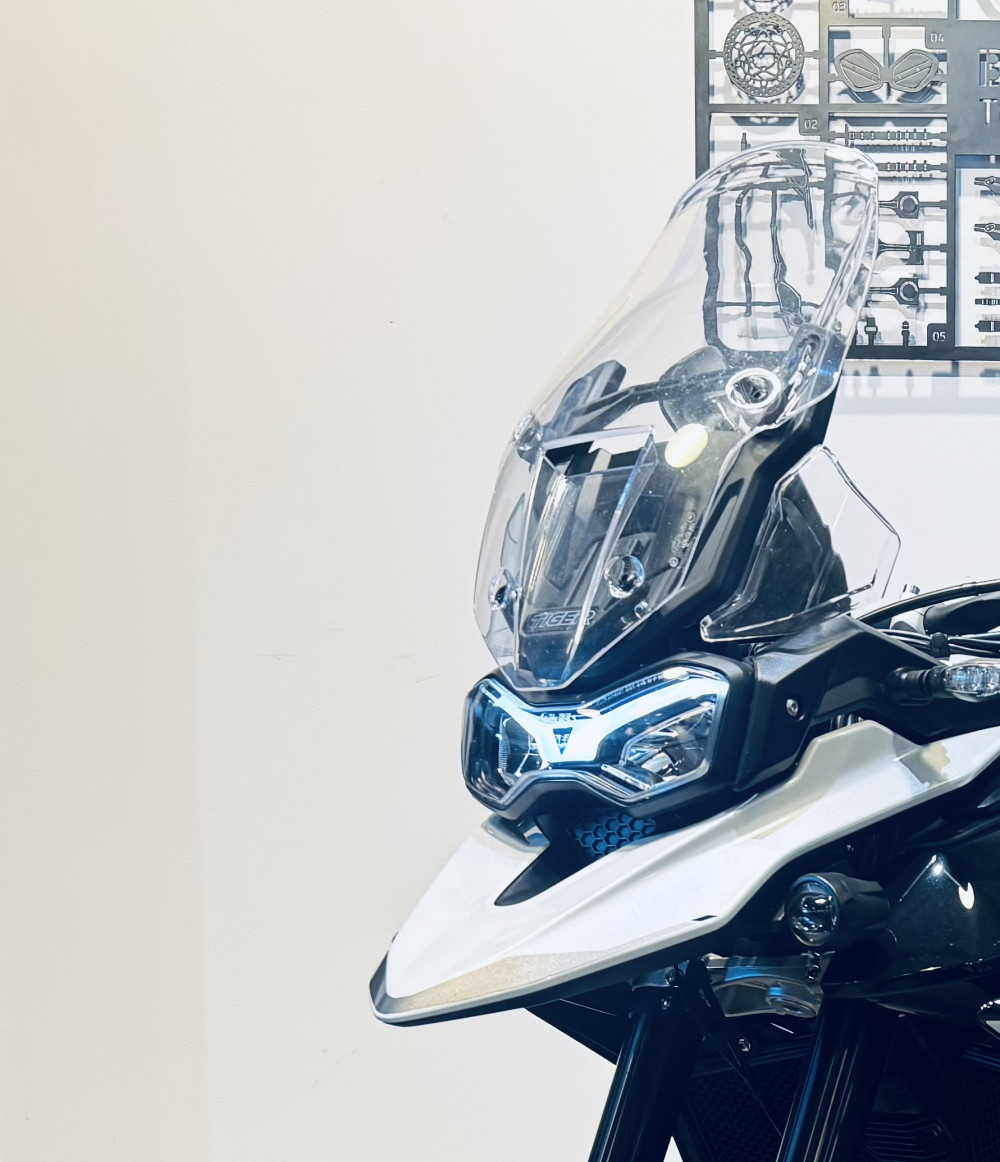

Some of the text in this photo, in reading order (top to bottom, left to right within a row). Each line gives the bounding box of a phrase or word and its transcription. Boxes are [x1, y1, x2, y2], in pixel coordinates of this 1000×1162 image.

[930, 32, 945, 43] 04
[804, 119, 818, 130] 02
[932, 331, 946, 342] 05
[530, 609, 597, 629] TIGER
